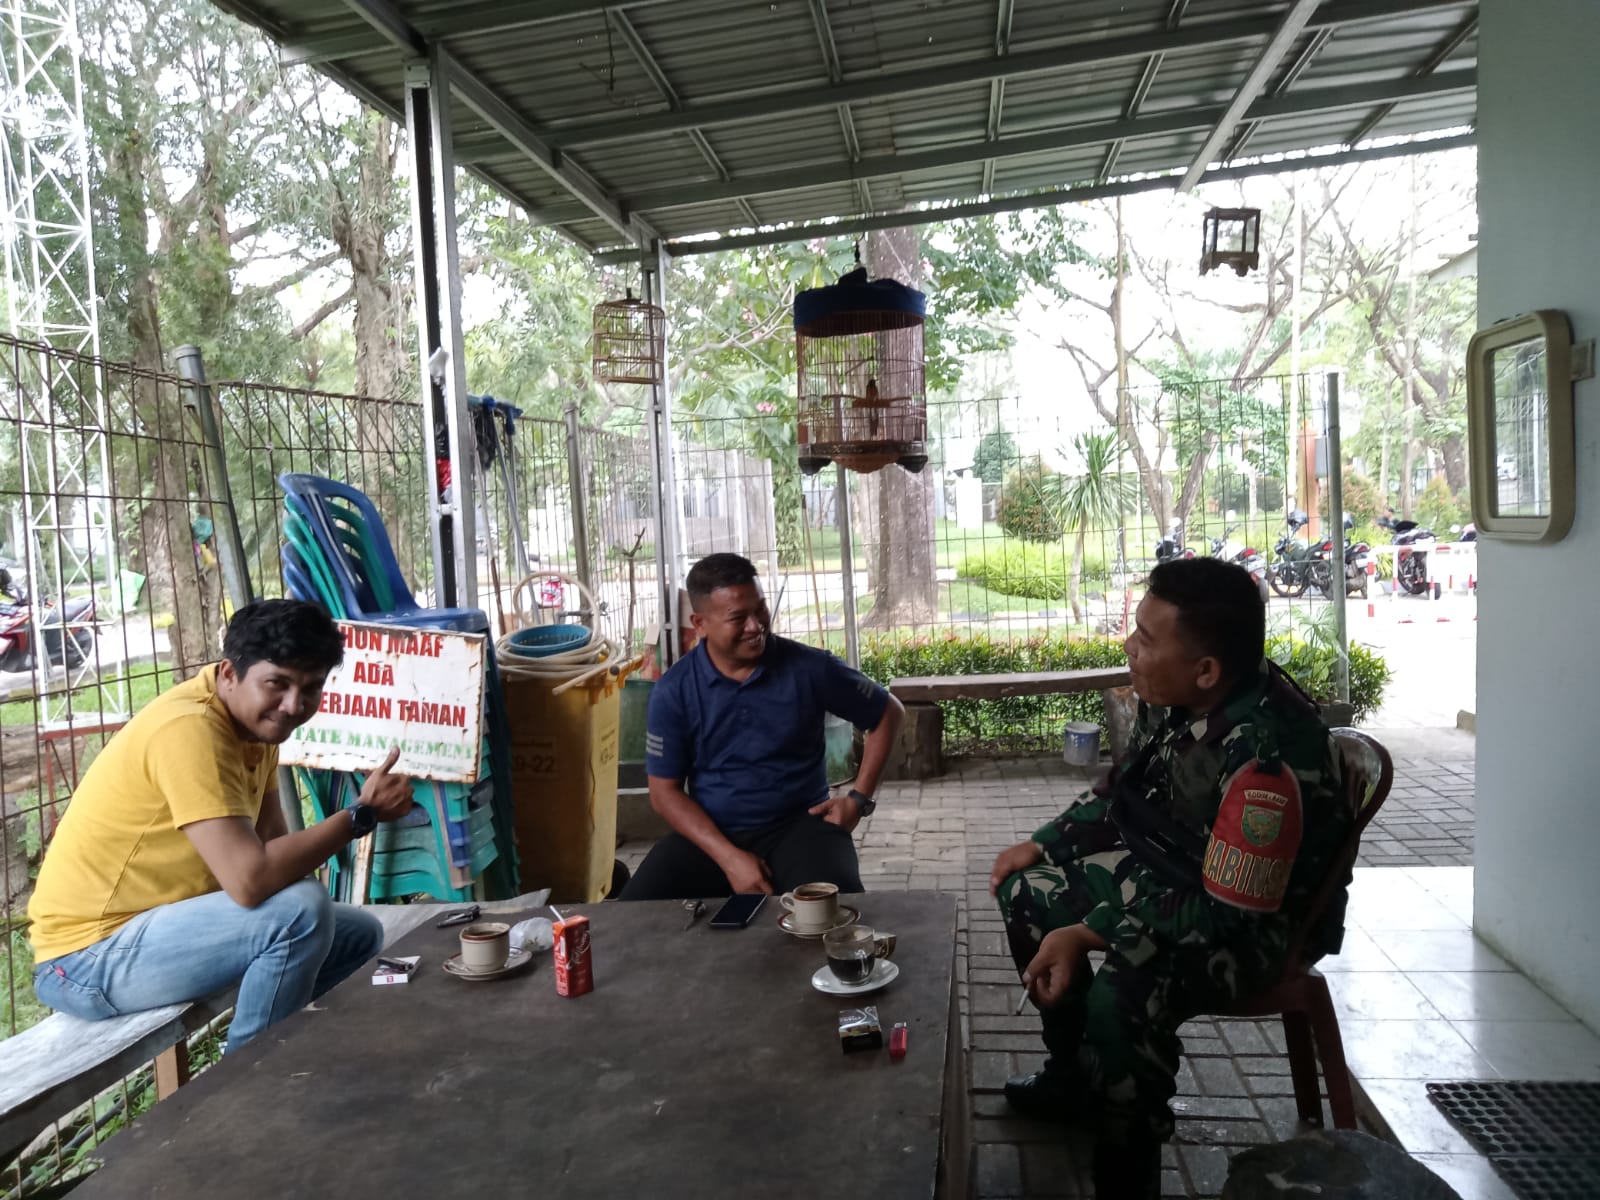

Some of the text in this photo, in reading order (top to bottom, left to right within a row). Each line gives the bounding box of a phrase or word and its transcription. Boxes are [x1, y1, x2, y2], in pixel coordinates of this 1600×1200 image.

[341, 626, 443, 658] HON MAAF
[353, 661, 395, 687] ADA
[318, 691, 466, 728] ERJAAN TAMAN
[295, 727, 342, 744] TATE
